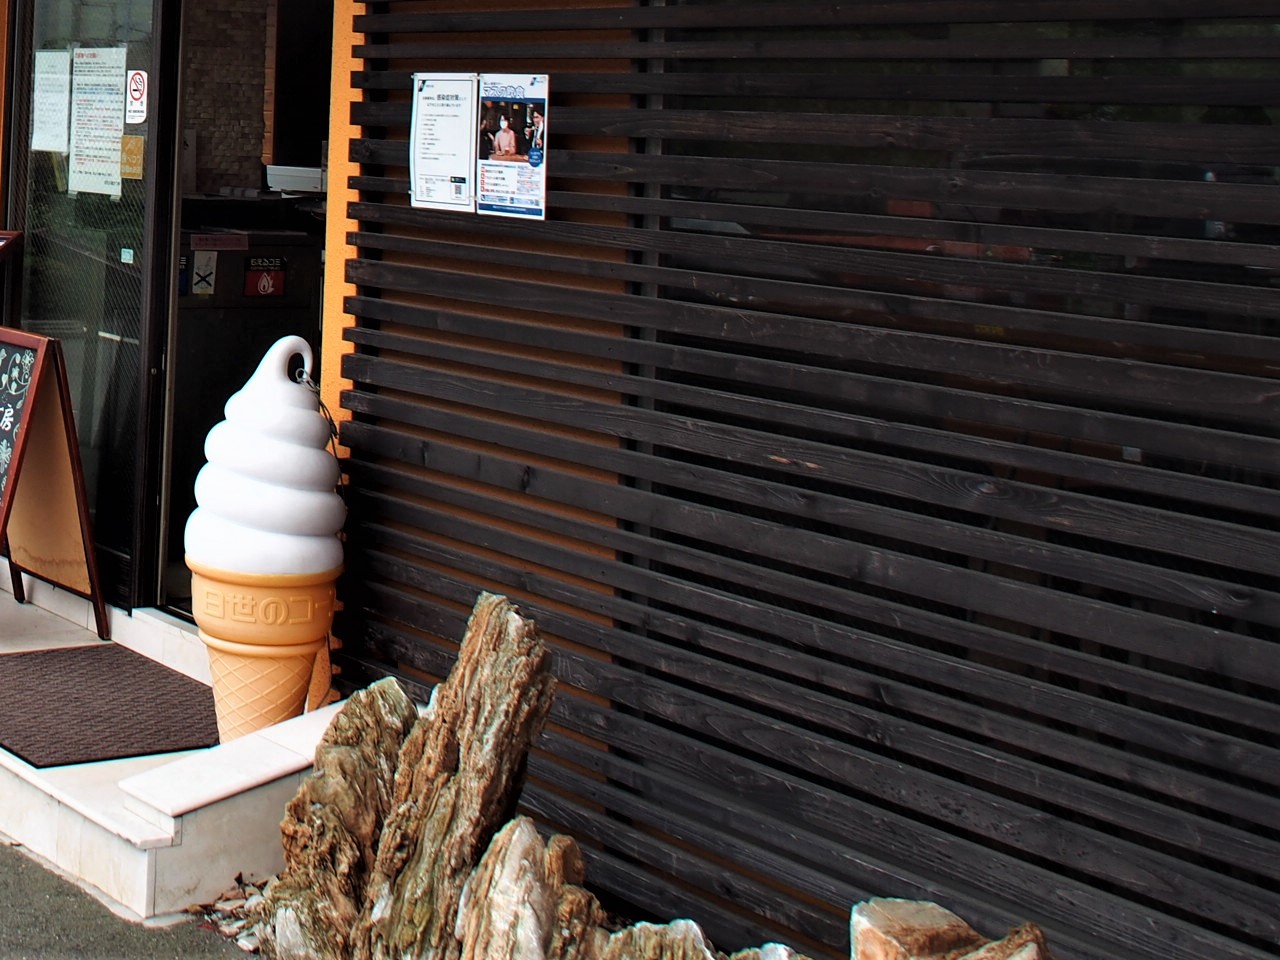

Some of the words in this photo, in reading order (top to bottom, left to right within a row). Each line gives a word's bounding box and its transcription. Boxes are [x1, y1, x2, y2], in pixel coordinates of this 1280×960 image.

[204, 589, 333, 626] 日世のコー
